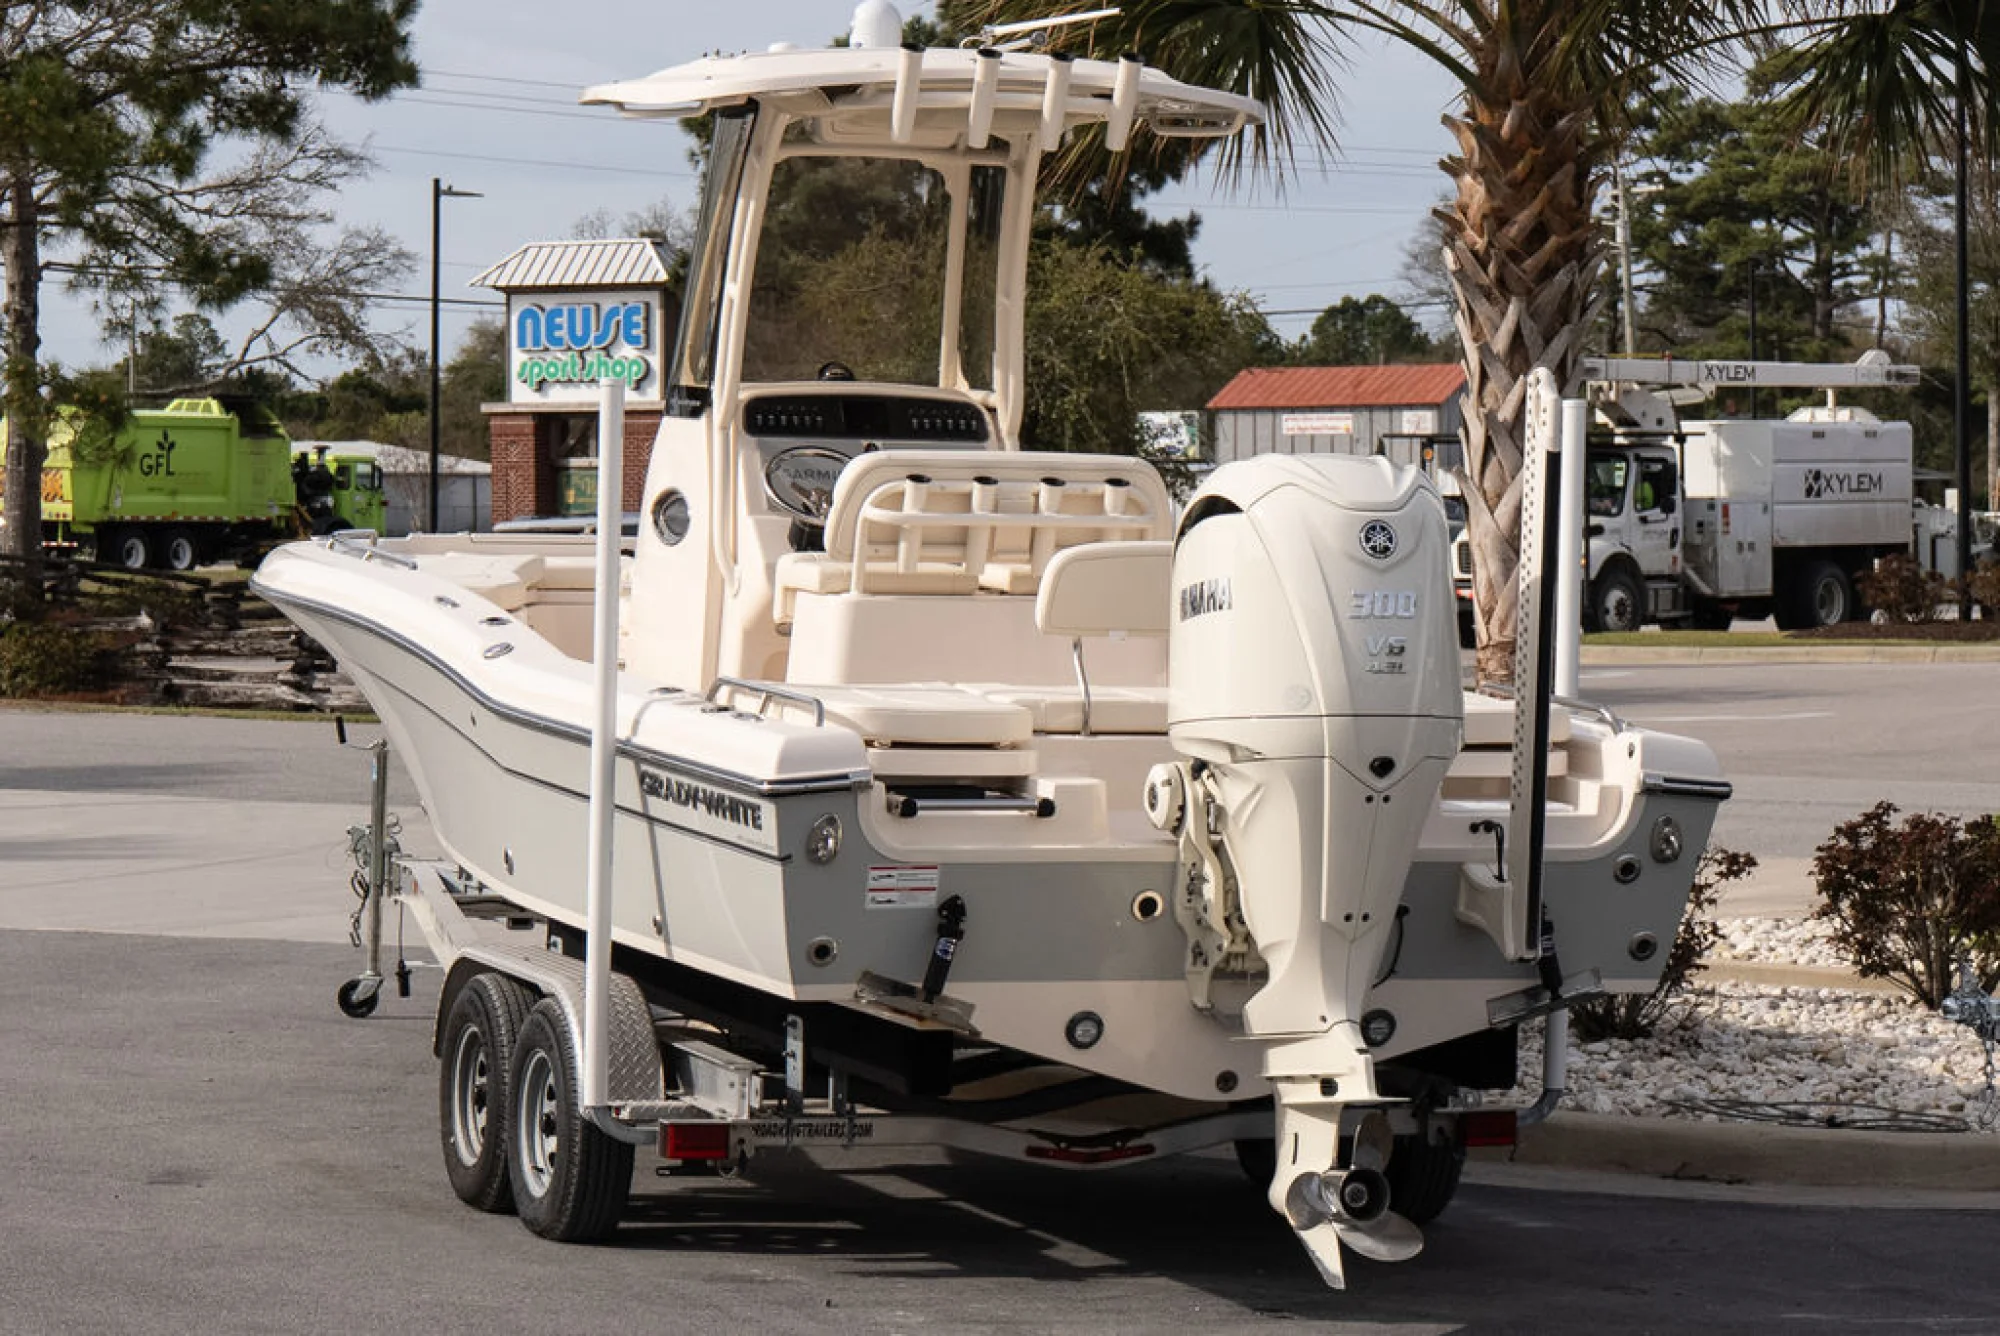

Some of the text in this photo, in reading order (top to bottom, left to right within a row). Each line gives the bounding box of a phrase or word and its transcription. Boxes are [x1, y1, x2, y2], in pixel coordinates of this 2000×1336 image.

[516, 303, 645, 350] NEUSE
[517, 351, 645, 389] sport shop
[1704, 364, 1757, 382] XYLEM
[140, 450, 176, 477] GFL
[1823, 472, 1882, 493] XYLEM
[1350, 591, 1416, 619] 300
[1367, 635, 1407, 656] V6
[640, 769, 763, 831] GRADY-WHITE
